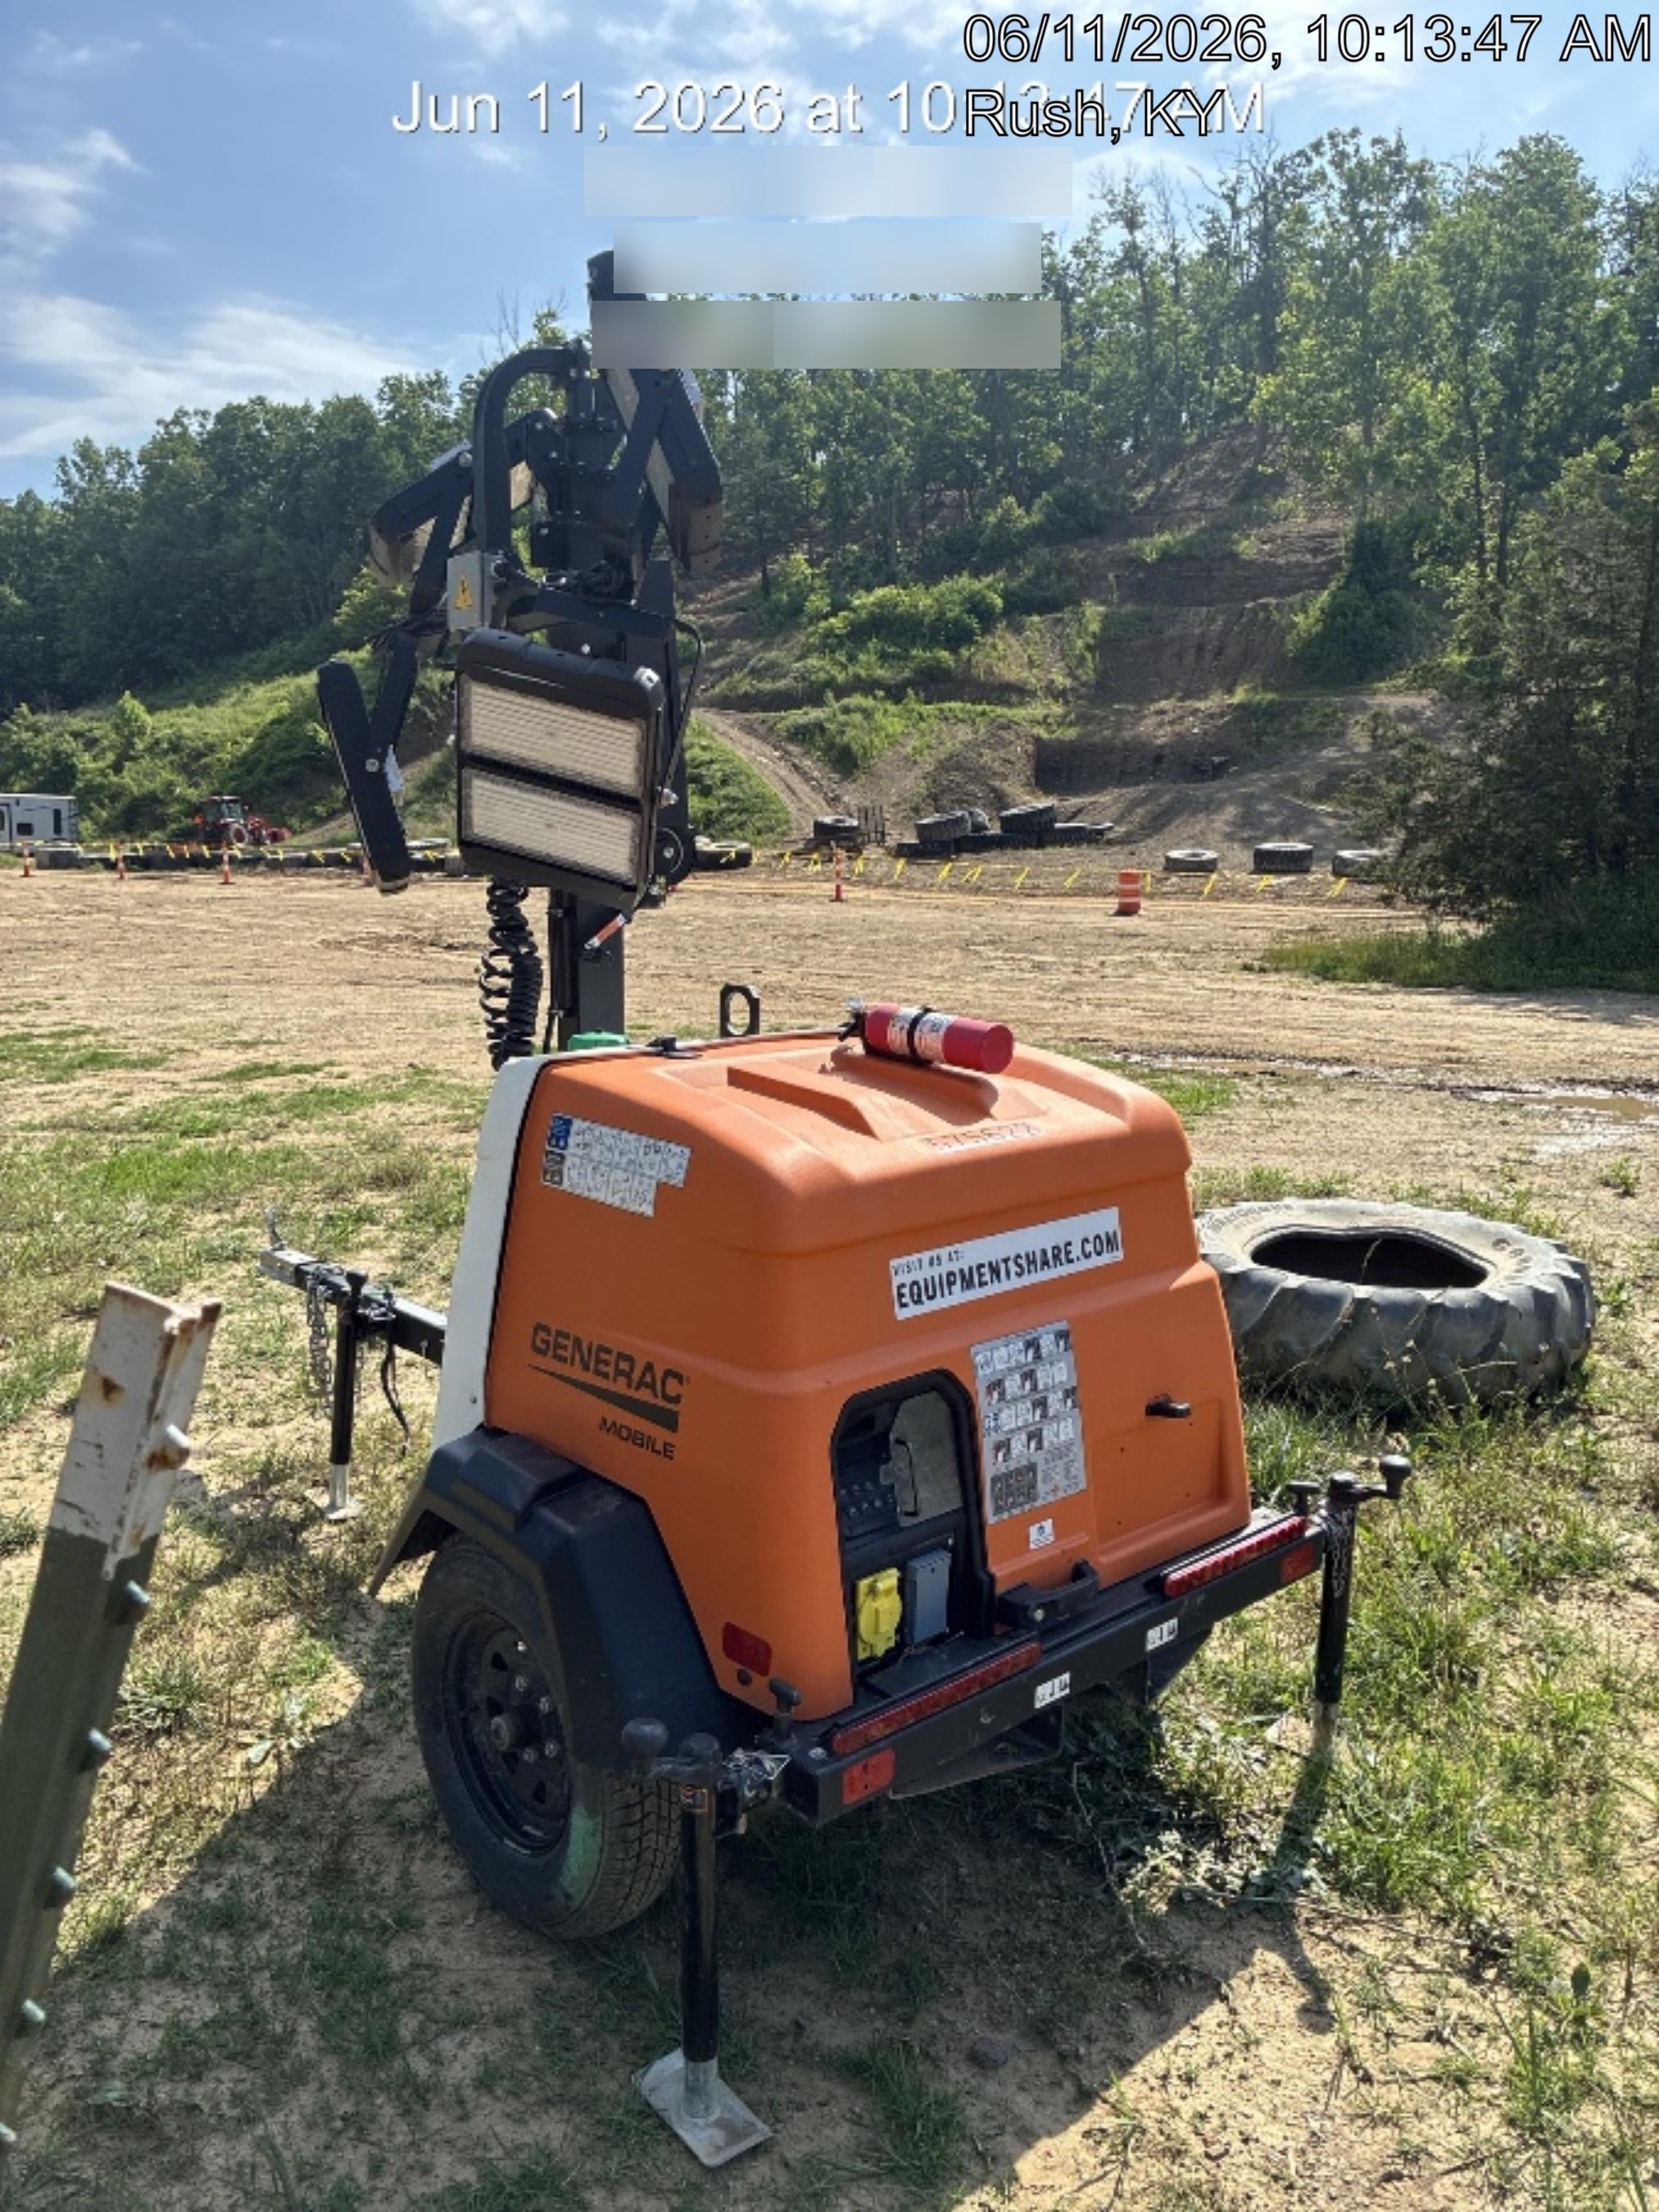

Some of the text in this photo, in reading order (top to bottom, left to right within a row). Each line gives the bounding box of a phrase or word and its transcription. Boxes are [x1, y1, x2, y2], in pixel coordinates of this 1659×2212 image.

[896, 1230, 1120, 1308] EQUIPMENTSHARE.COM
[530, 1321, 684, 1404] GENERAC
[599, 1416, 676, 1460] MOBILE
